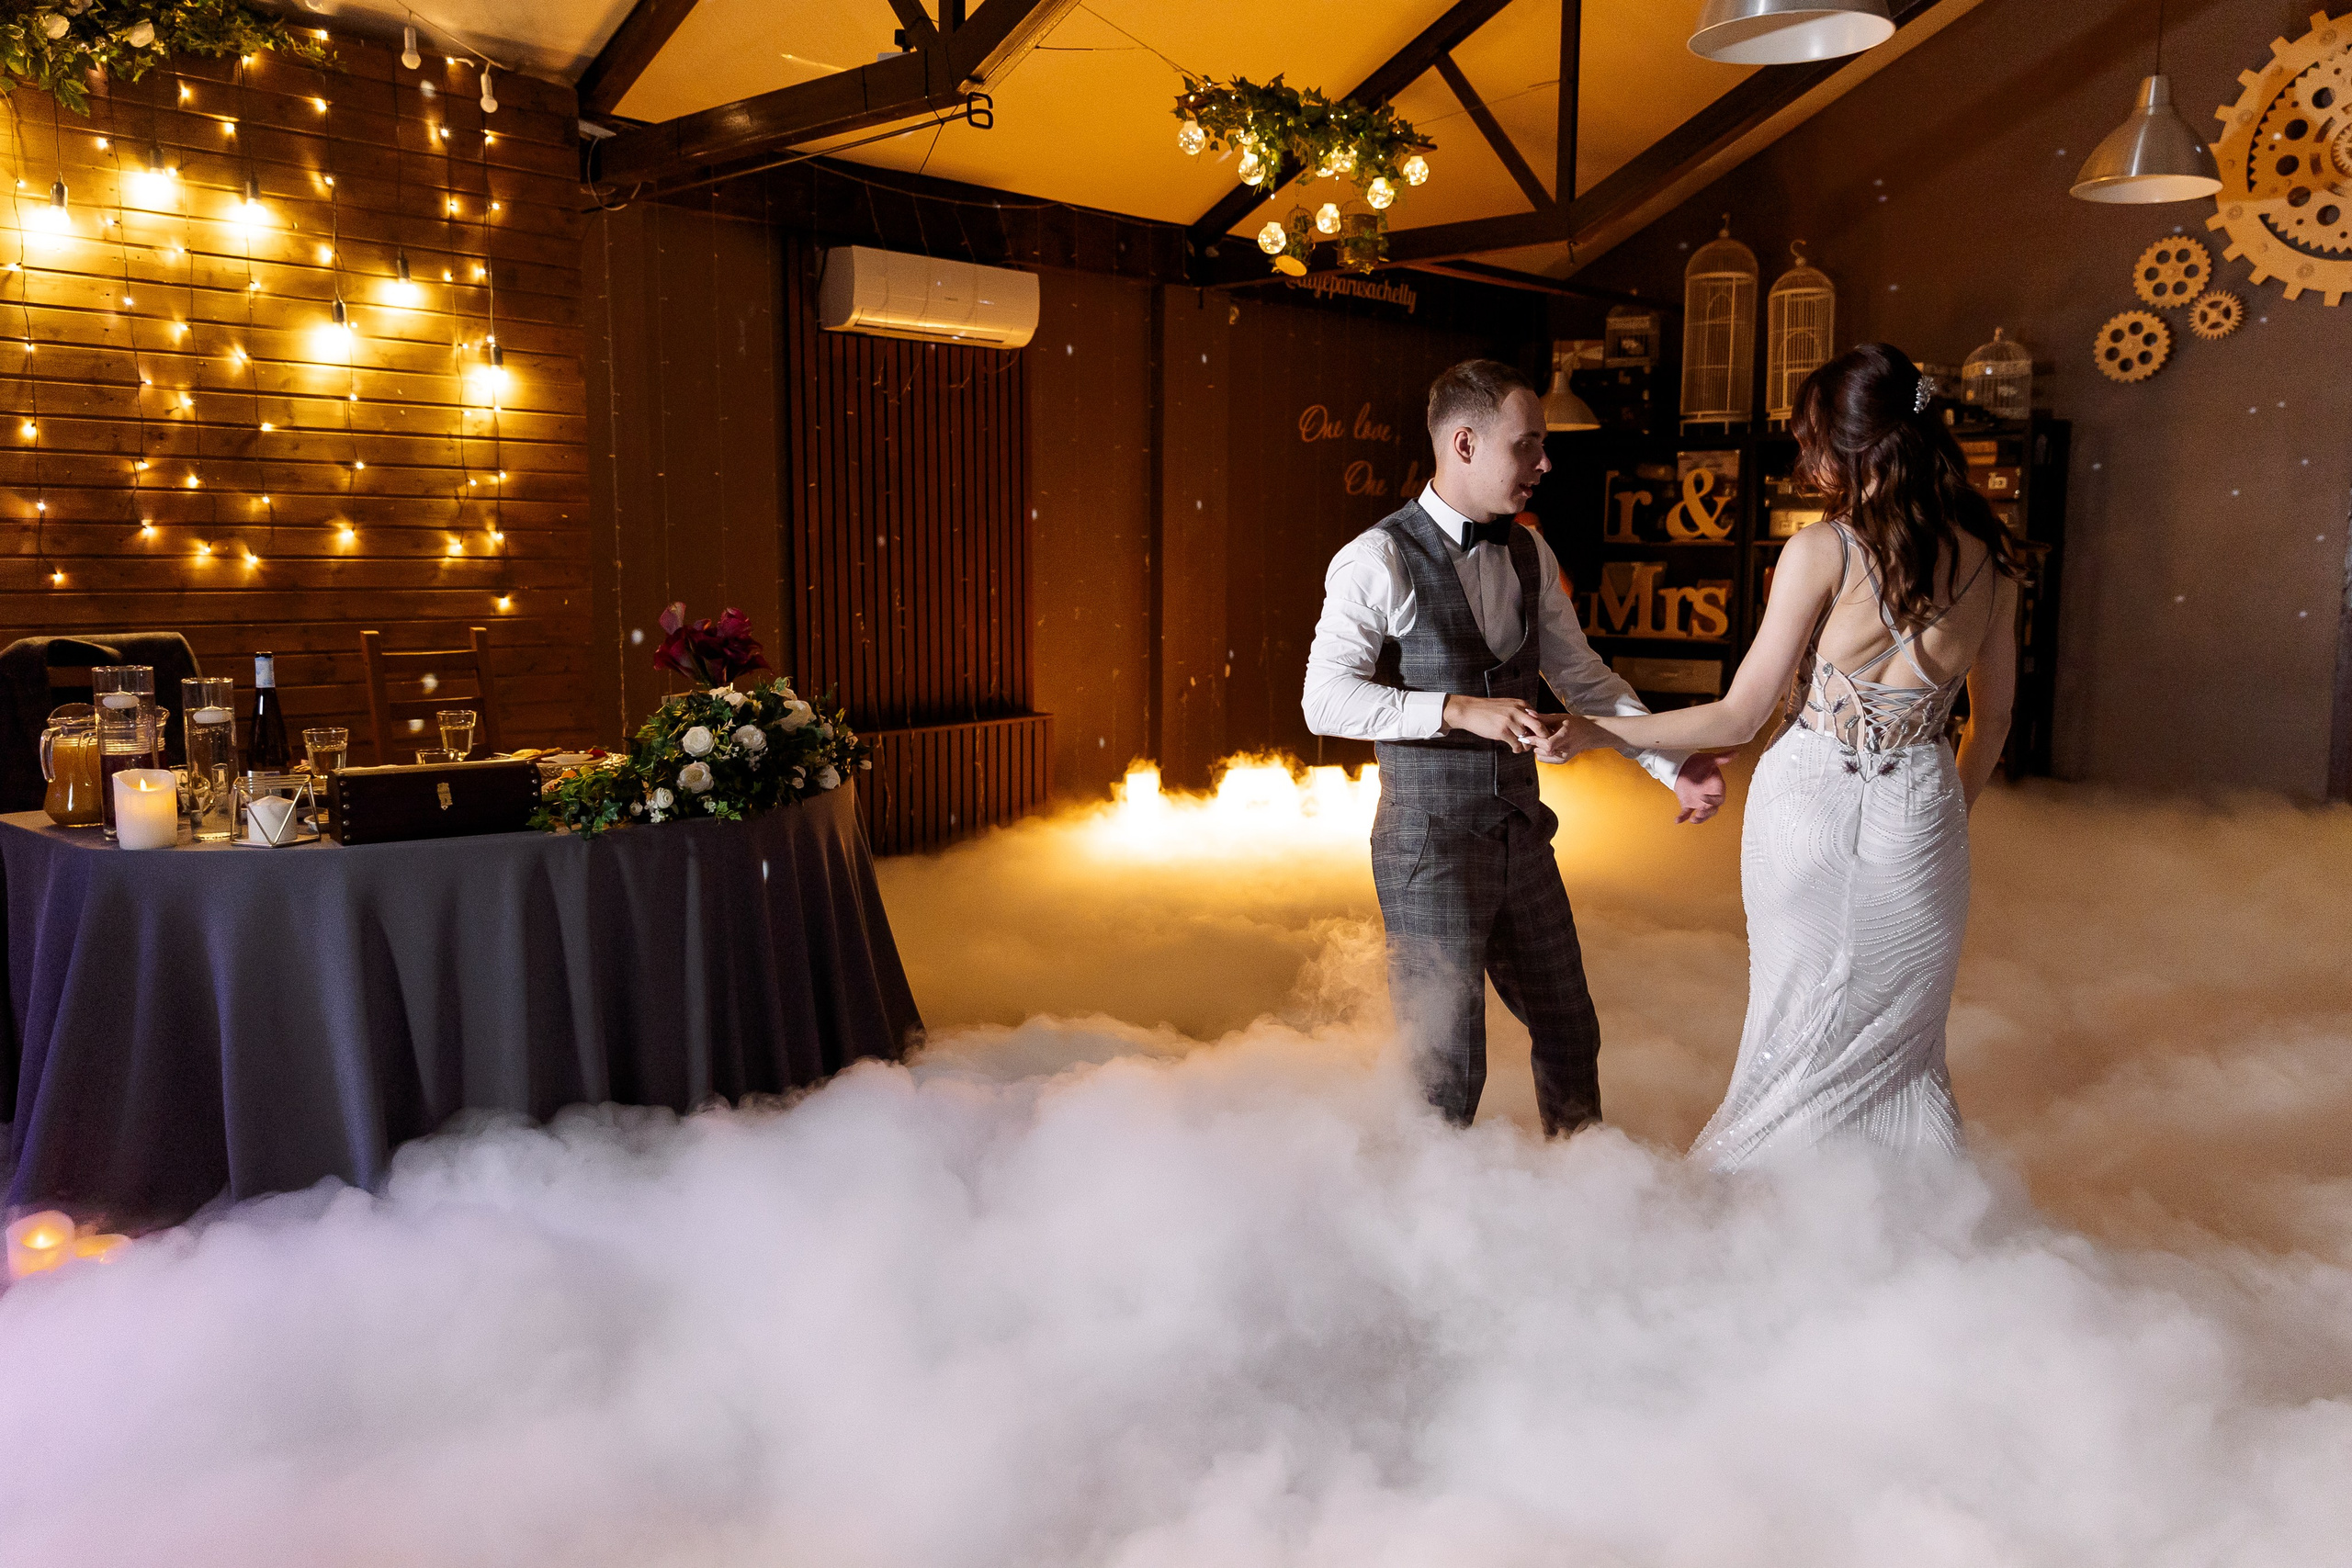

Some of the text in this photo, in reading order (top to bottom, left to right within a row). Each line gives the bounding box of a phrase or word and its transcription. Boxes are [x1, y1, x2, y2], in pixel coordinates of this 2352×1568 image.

[1298, 403, 1345, 443] One
[1344, 459, 1388, 496] One
[1665, 468, 1735, 540] &
[1581, 563, 1730, 637] Mrs
